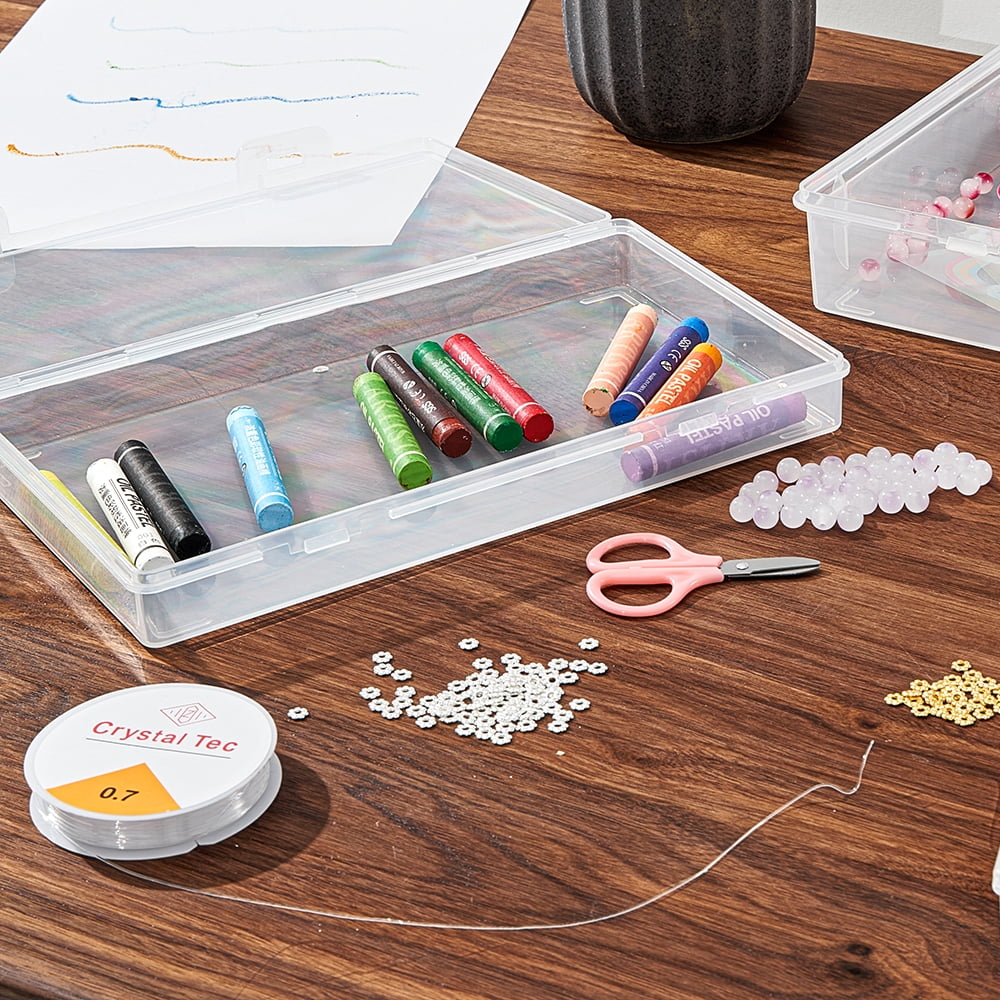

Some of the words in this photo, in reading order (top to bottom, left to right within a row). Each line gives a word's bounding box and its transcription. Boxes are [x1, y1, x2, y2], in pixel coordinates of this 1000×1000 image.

[683, 358, 702, 376] OIL
[655, 372, 691, 406] PASTEL
[743, 403, 771, 424] OIL
[116, 476, 133, 492] OIL
[126, 491, 153, 527] PASTEL
[92, 720, 188, 745] Crystal
[195, 734, 239, 753] Tec
[99, 786, 139, 802] 0.7
